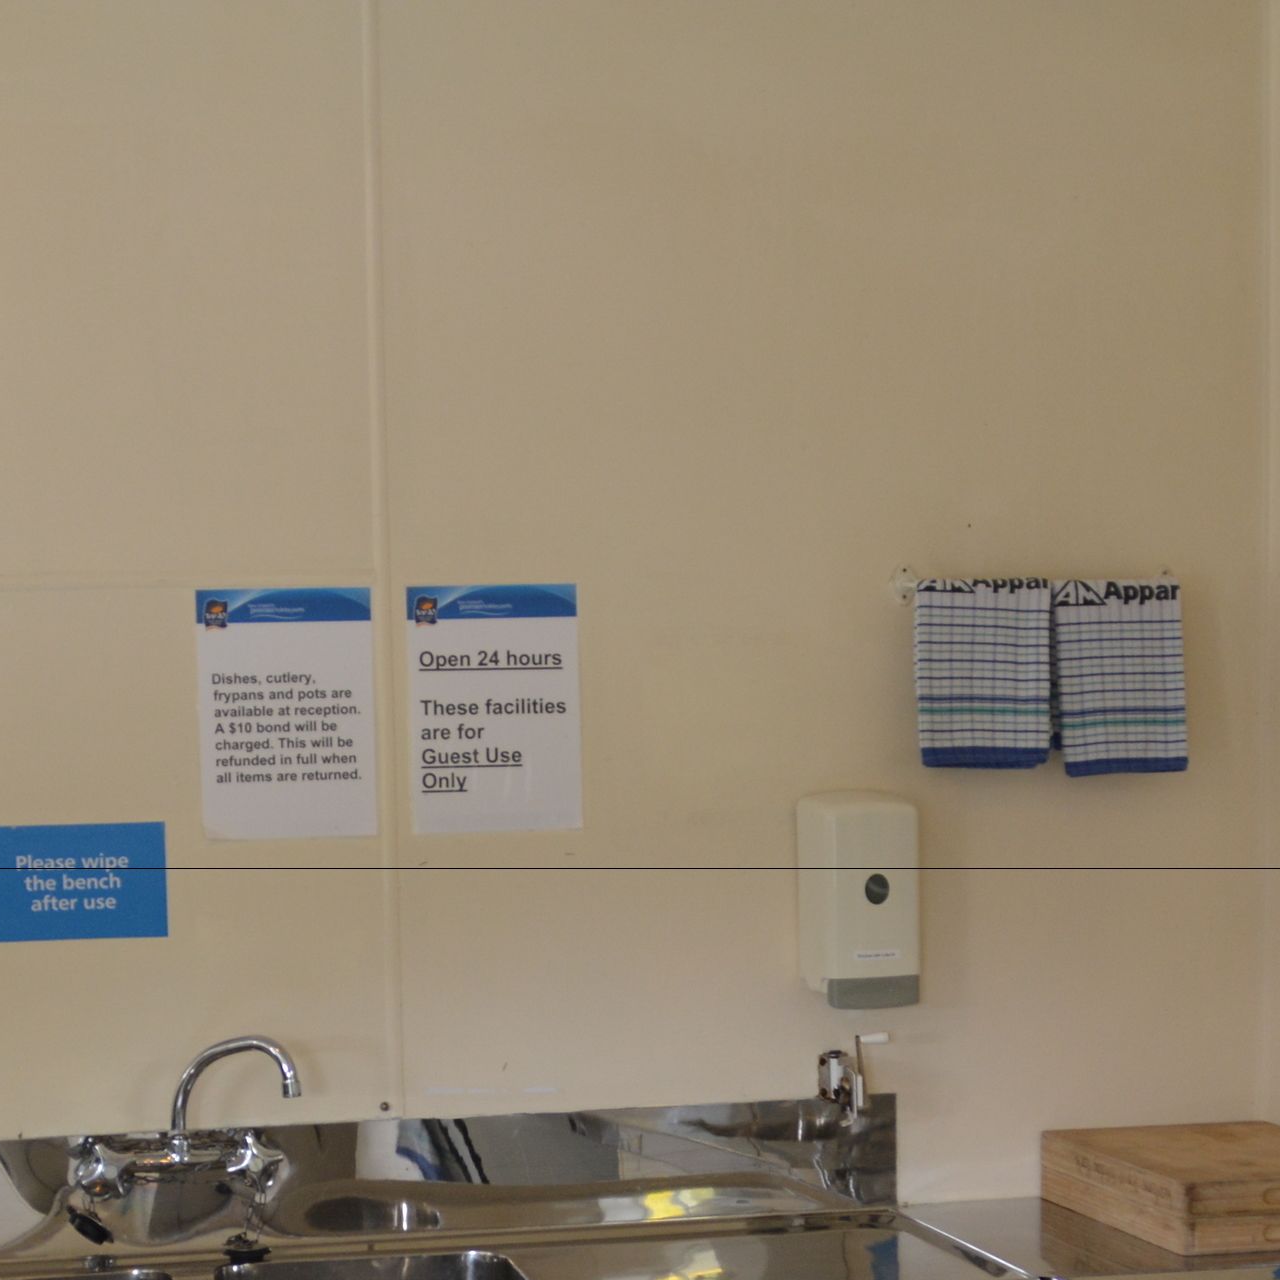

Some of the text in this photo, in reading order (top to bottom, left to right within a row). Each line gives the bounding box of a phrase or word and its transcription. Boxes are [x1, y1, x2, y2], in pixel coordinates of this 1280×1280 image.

[1104, 581, 1180, 605] Appar
[419, 650, 562, 670] Open 24 hours
[211, 672, 316, 685] Dishes, cutlery,
[213, 688, 352, 703] frypans and pots are
[214, 704, 361, 718] available at reception.
[420, 698, 567, 716] These facilities
[214, 720, 337, 734] A $10 bond will be
[421, 723, 484, 740] are for
[215, 736, 353, 752] charged. This will be
[216, 753, 357, 767] refunded in full when
[422, 747, 522, 765] Guest Use
[216, 769, 362, 783] all items are returned.
[422, 772, 467, 792] Only
[15, 852, 129, 873] Please wipe
[24, 872, 122, 891] the bench
[31, 894, 117, 912] after use
